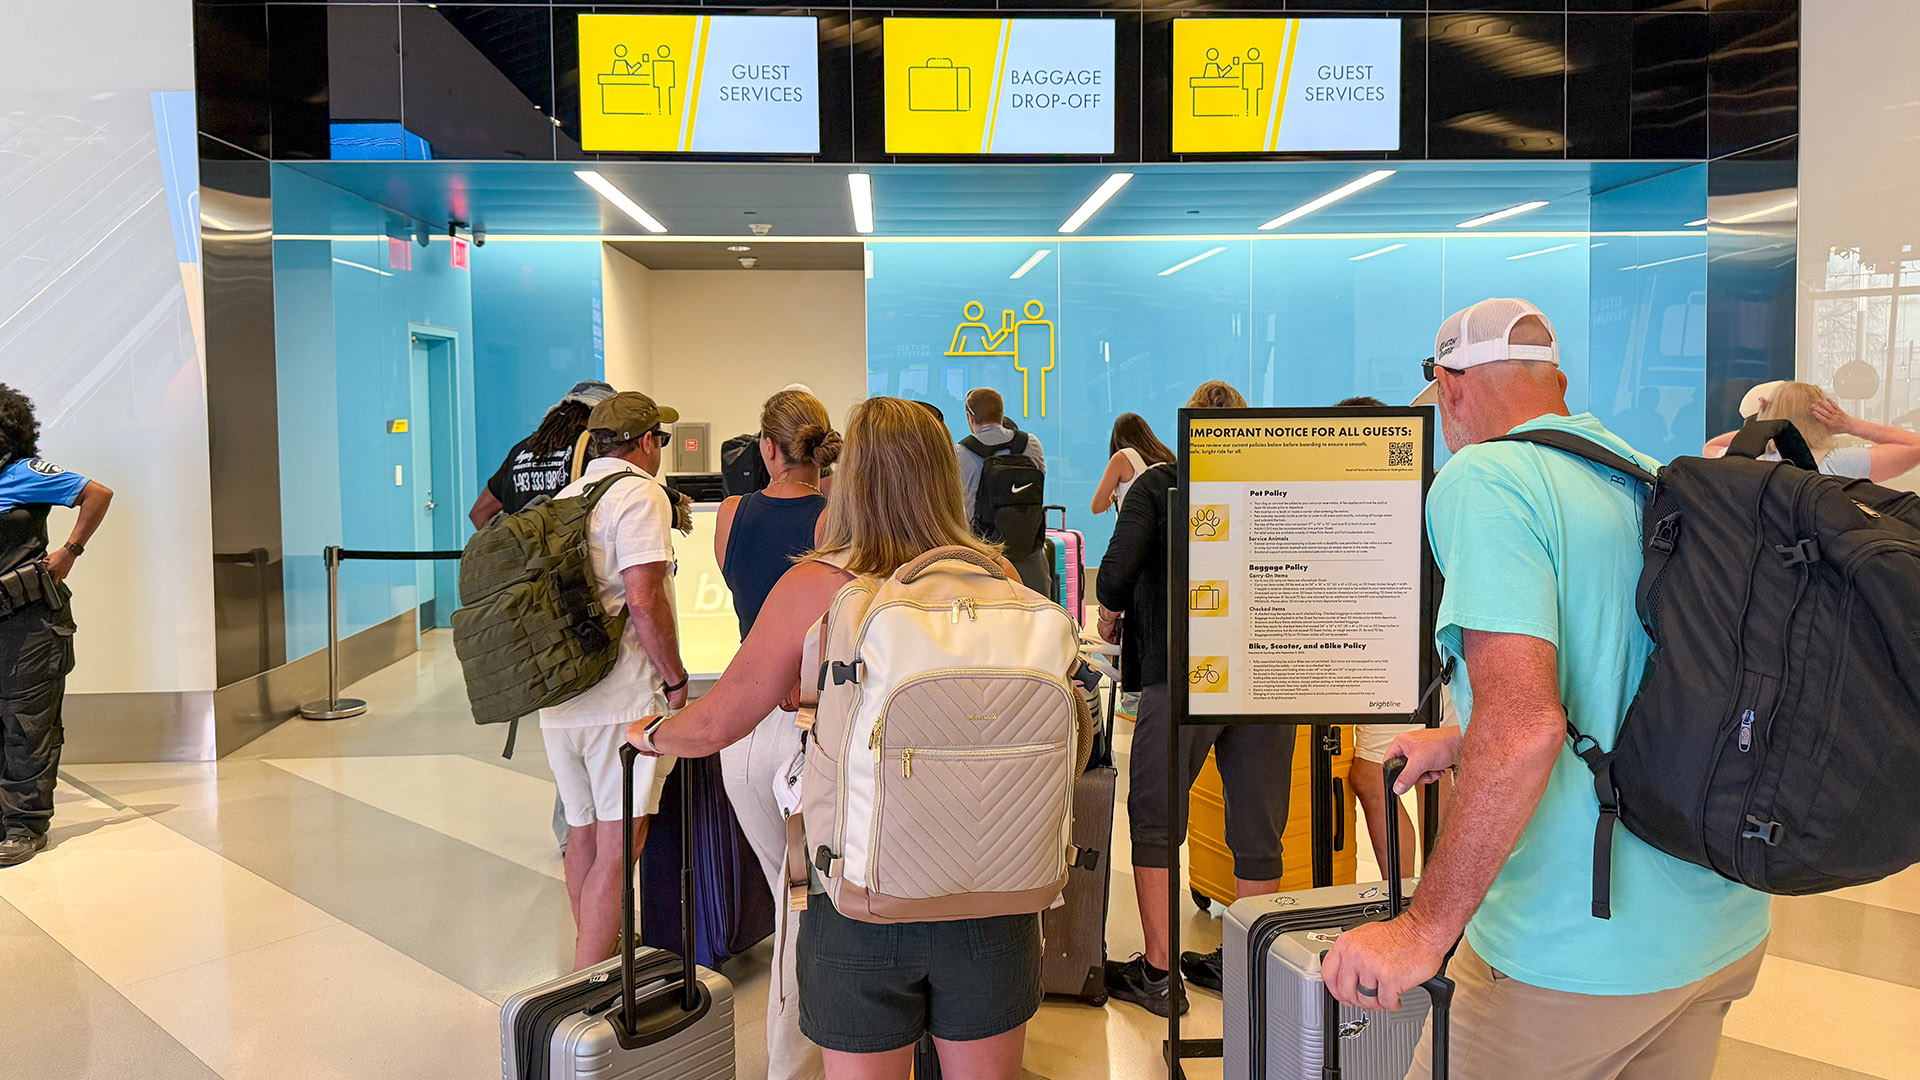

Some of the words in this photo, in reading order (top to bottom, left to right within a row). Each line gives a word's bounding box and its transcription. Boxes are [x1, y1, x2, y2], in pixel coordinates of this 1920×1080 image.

[731, 64, 790, 80] GUEST
[1011, 69, 1102, 85] BAGGAGE
[1317, 65, 1373, 80] GUEST
[719, 86, 803, 102] SERVICES
[1012, 93, 1101, 109] DROP-OFF
[1305, 86, 1385, 102] SERVICES
[1190, 428, 1262, 438] IMPORTANT
[1264, 427, 1308, 437] NOTICE
[1311, 427, 1335, 437] FOR
[1338, 427, 1359, 437] ALL
[1362, 426, 1412, 437] GUESTS:
[1264, 489, 1288, 498] Policy
[1249, 564, 1283, 572] Baggage
[1285, 563, 1309, 572] Policy
[1343, 642, 1367, 651] Policy
[1368, 700, 1402, 710] brightline
